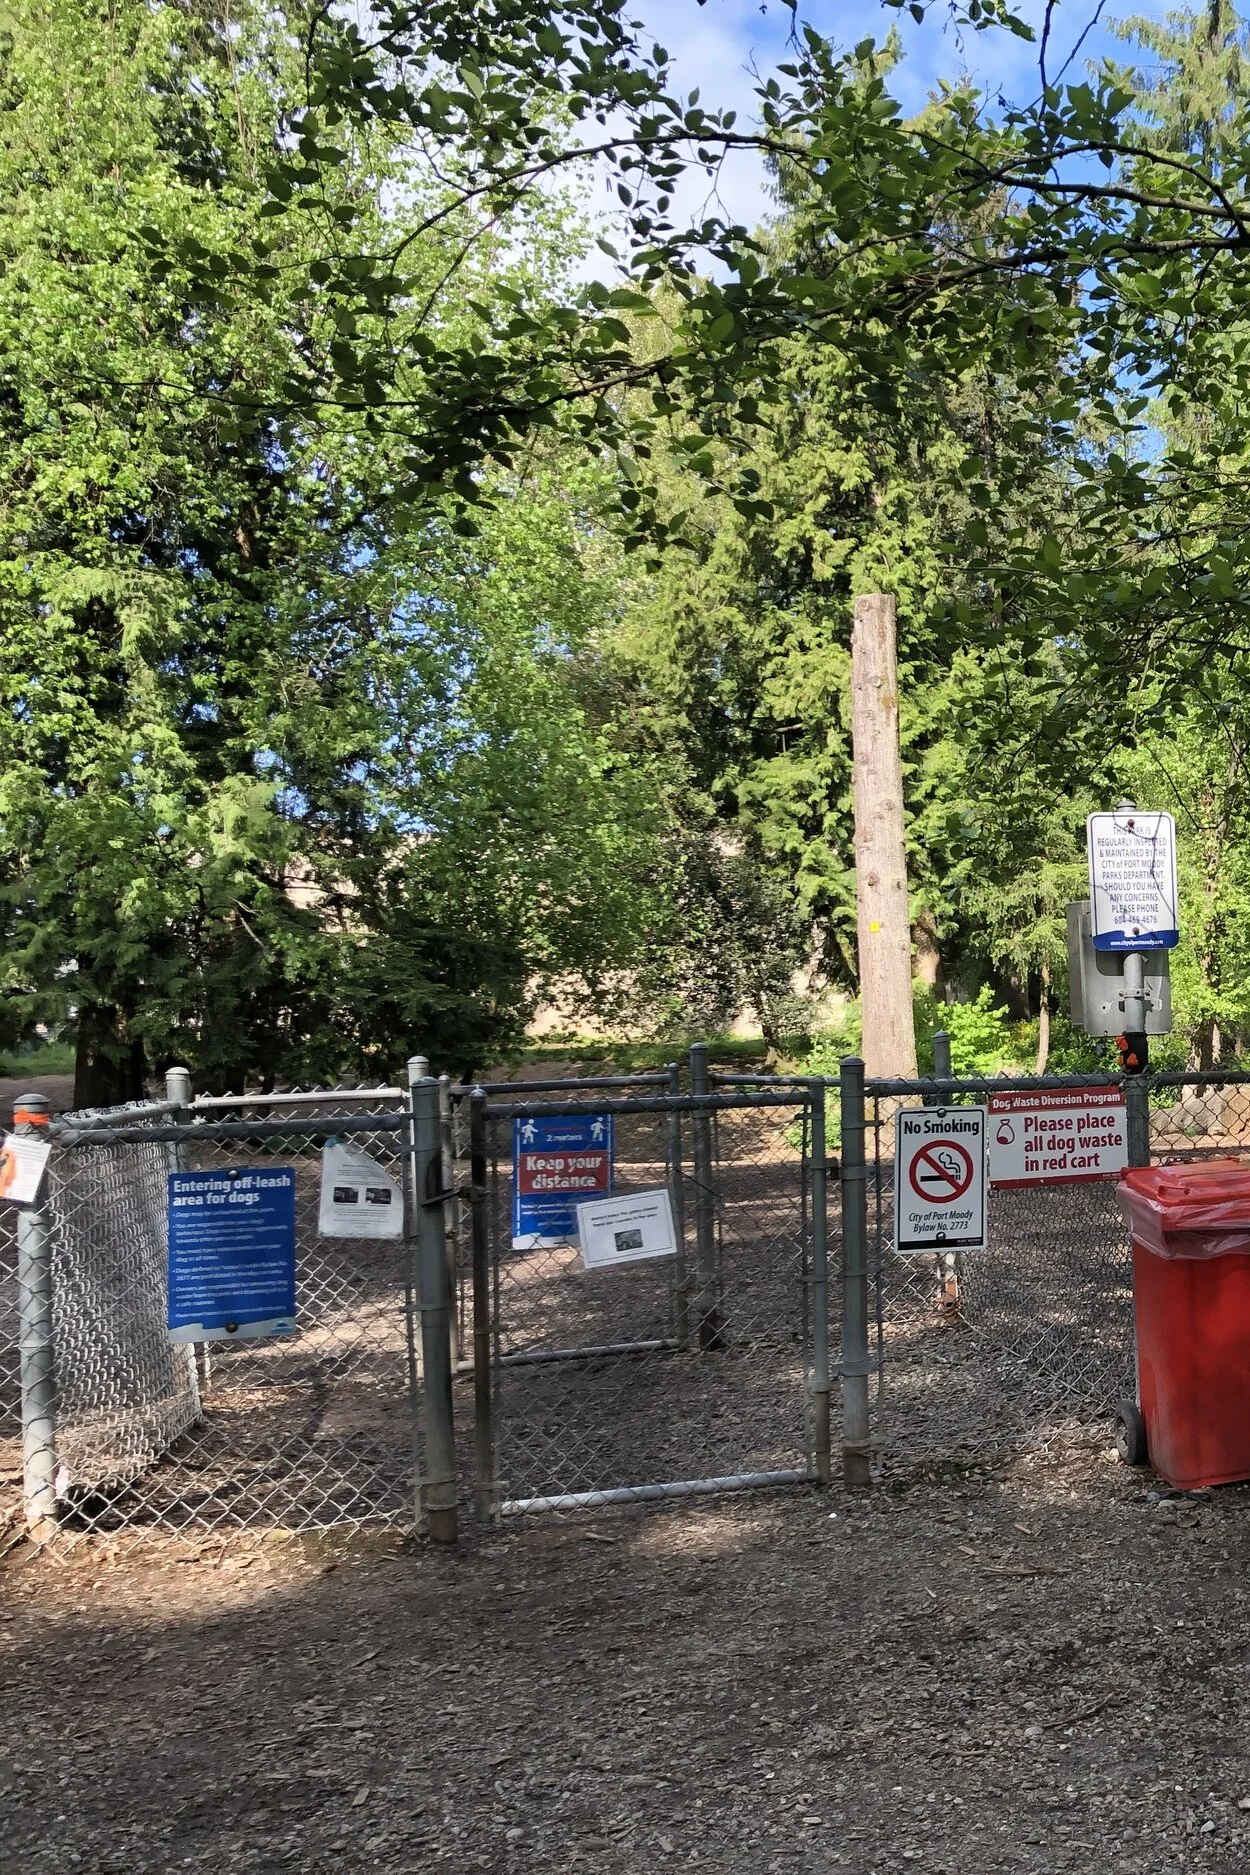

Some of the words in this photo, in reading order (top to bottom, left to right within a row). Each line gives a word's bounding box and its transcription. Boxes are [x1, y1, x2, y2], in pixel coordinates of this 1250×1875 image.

[1146, 826, 1151, 834] IS
[1097, 838, 1132, 846] REGULARLY
[1100, 849, 1104, 858] &
[1106, 849, 1144, 857] MAINTAINED
[1146, 848, 1153, 857] BY
[1154, 848, 1166, 857] THE
[1102, 860, 1116, 868] CITY
[1116, 860, 1122, 868] of
[1124, 860, 1140, 868] PORT
[1102, 871, 1122, 880] PARKS
[1104, 882, 1132, 891] SHOULD
[1132, 882, 1145, 890] YOU
[1110, 893, 1122, 902] ANY
[1112, 904, 1135, 913] PLEASE
[1137, 904, 1158, 912] PHONE
[992, 1099, 1011, 1110] Dog
[1012, 1097, 1040, 1107] Waste
[1041, 1094, 1082, 1105] Diversion
[1084, 1093, 1120, 1104] Program
[904, 1120, 921, 1134] No
[923, 1119, 980, 1136] Smoking
[1024, 1116, 1073, 1133] Please
[1077, 1113, 1115, 1133] place
[1024, 1136, 1043, 1152] all
[1047, 1135, 1075, 1153] dog
[1079, 1133, 1122, 1148] waste
[526, 1156, 565, 1174] Keep
[568, 1157, 602, 1173] your
[1025, 1156, 1039, 1172] in
[1043, 1154, 1067, 1170] red
[1071, 1153, 1100, 1168] cart
[174, 1178, 231, 1192] Entering
[234, 1174, 290, 1189] off-leash
[532, 1173, 597, 1189] distance
[173, 1196, 204, 1206] area
[206, 1192, 226, 1204] for
[228, 1190, 260, 1205] dogs
[909, 1212, 924, 1223] City
[924, 1212, 934, 1222] of
[933, 1211, 948, 1220] Port
[949, 1210, 973, 1220] Moody
[913, 1223, 936, 1234] Bylaw
[937, 1222, 948, 1230] No.
[950, 1221, 968, 1230] 2773
